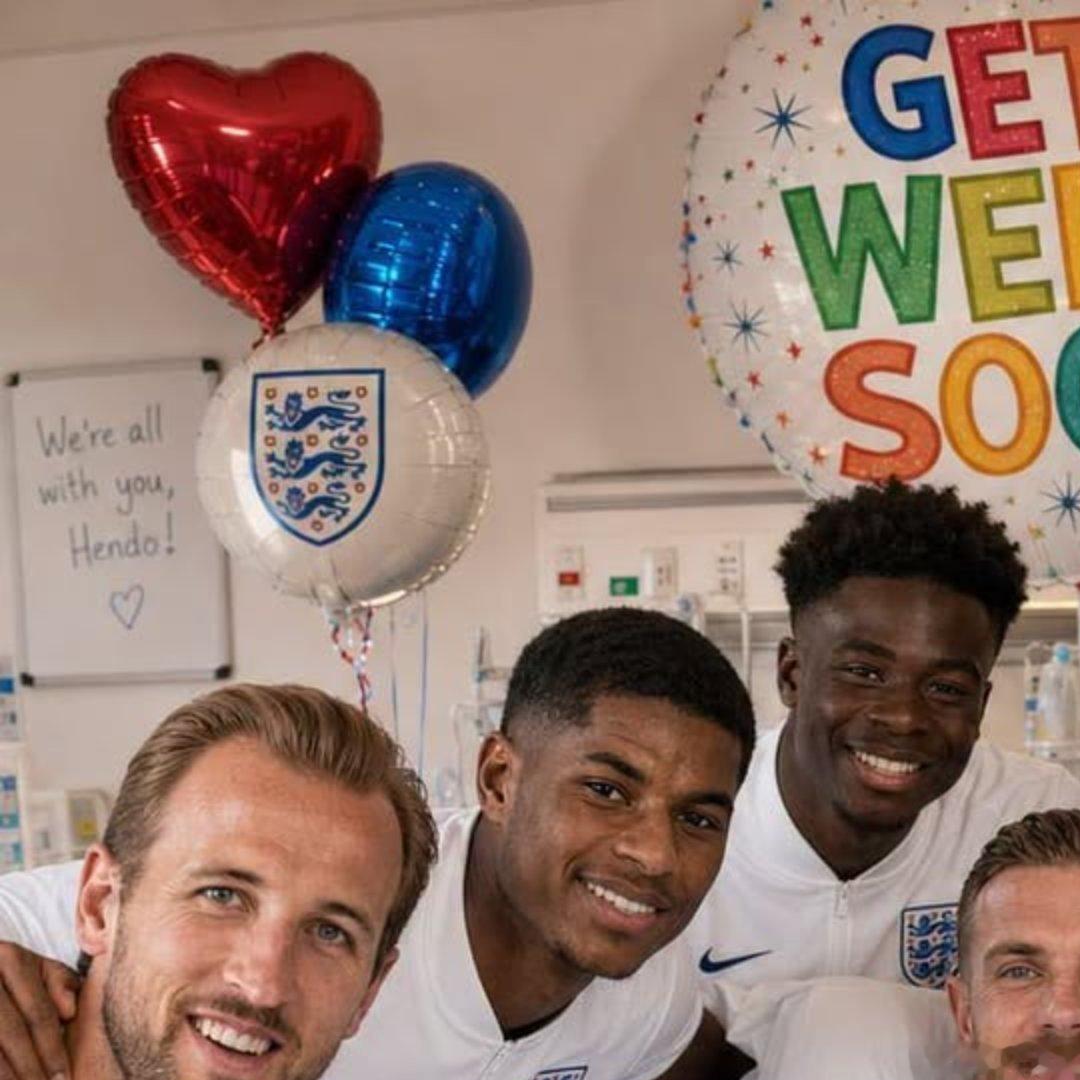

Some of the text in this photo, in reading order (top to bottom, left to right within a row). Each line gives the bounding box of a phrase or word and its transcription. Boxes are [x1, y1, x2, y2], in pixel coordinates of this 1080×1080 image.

[36, 403, 163, 458] We're all
[38, 467, 175, 516] with you,
[68, 511, 176, 570] Hendo!
